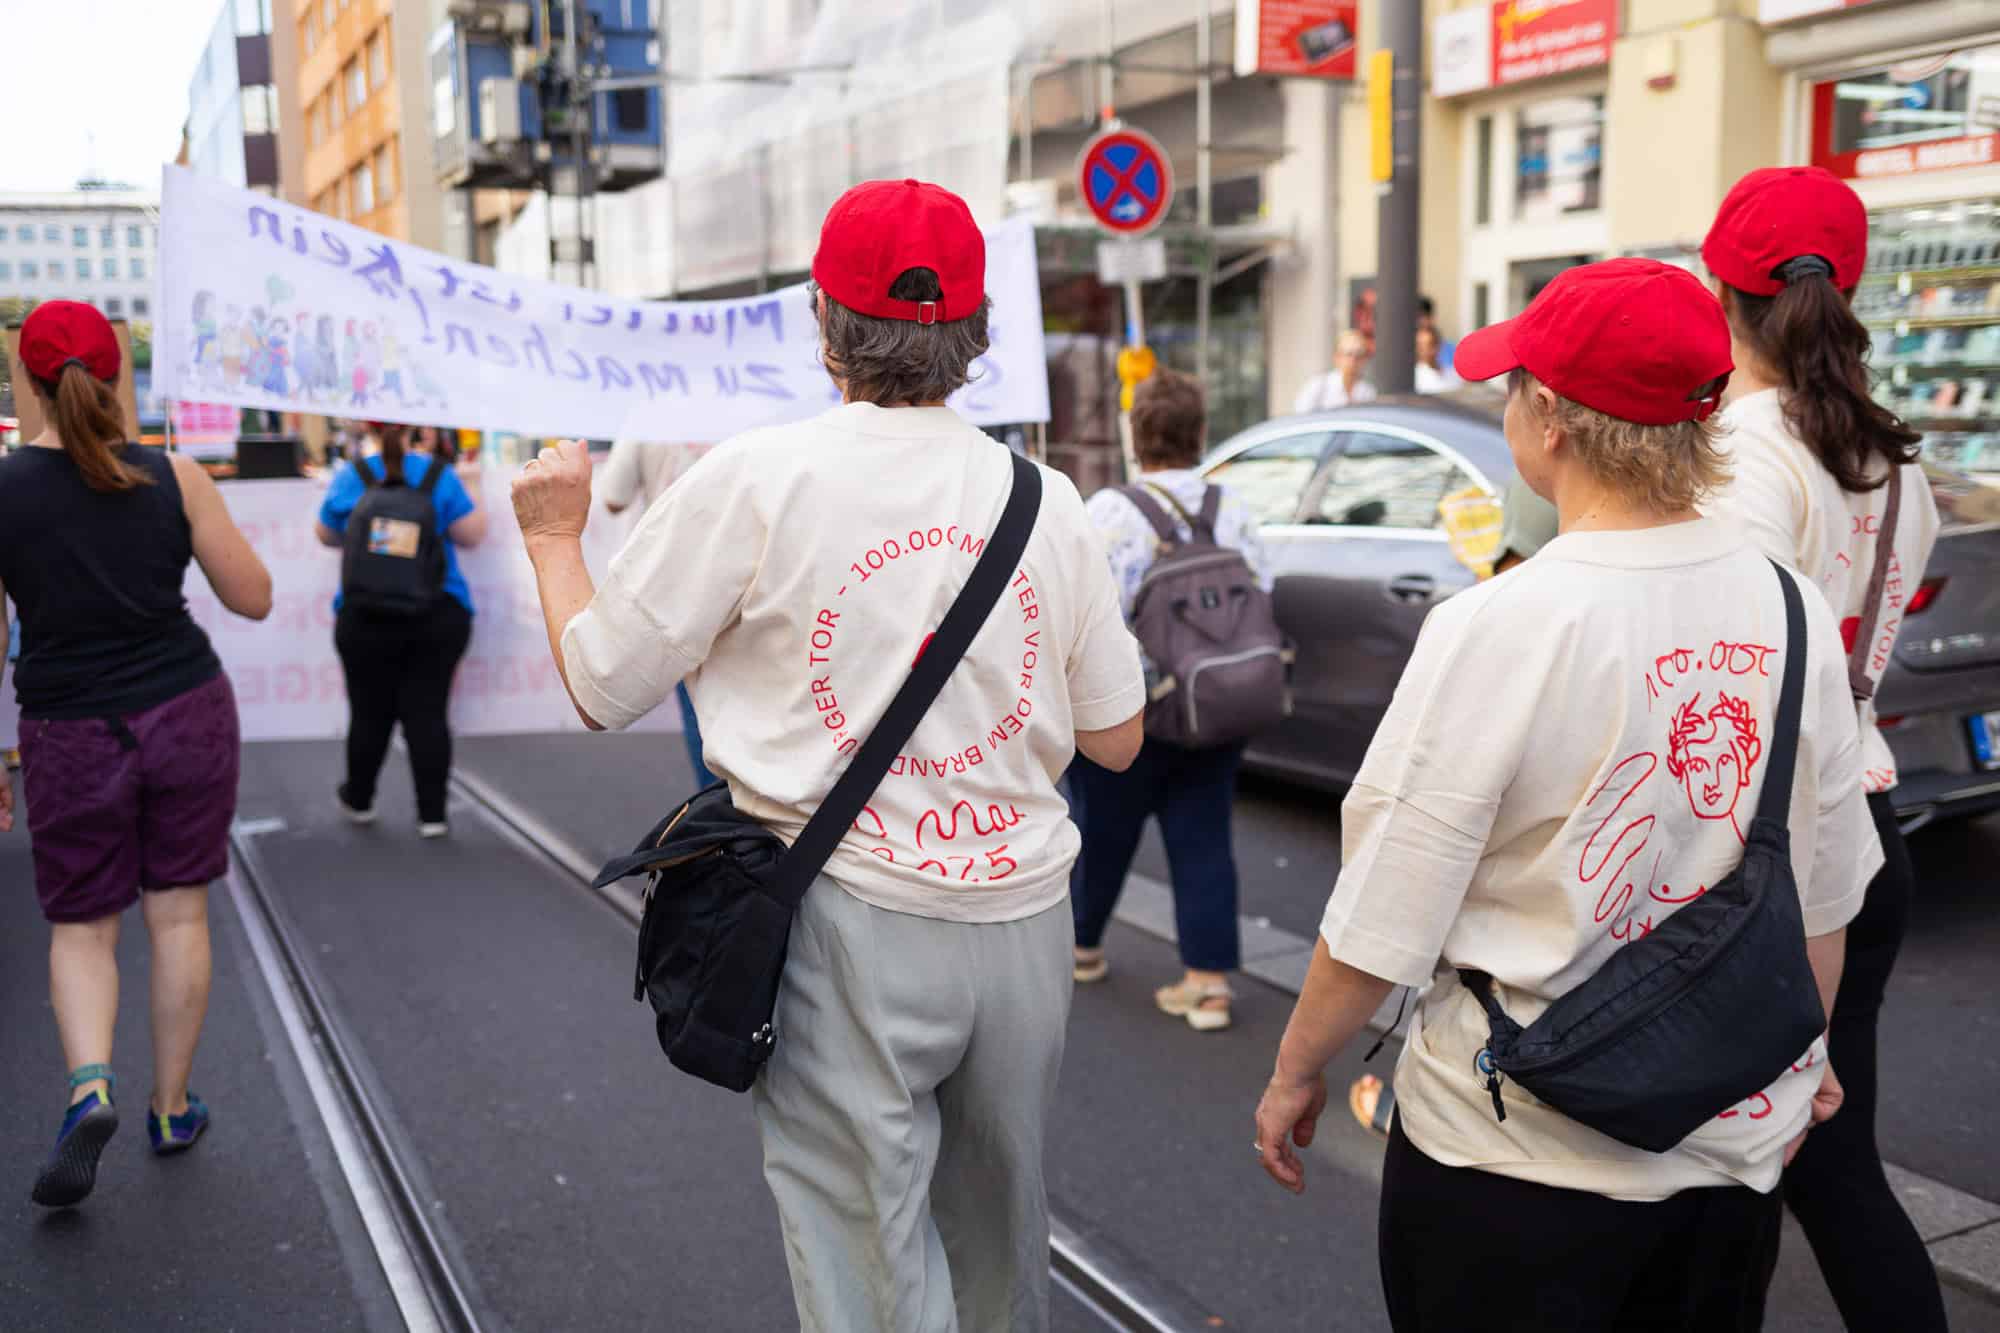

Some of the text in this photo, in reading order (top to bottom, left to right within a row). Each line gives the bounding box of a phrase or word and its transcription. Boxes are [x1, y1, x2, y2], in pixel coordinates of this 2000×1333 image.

[959, 532, 1040, 624] MTER
[808, 607, 841, 667] TOR
[1020, 629, 1041, 690] VOR
[986, 696, 1033, 751] DEM
